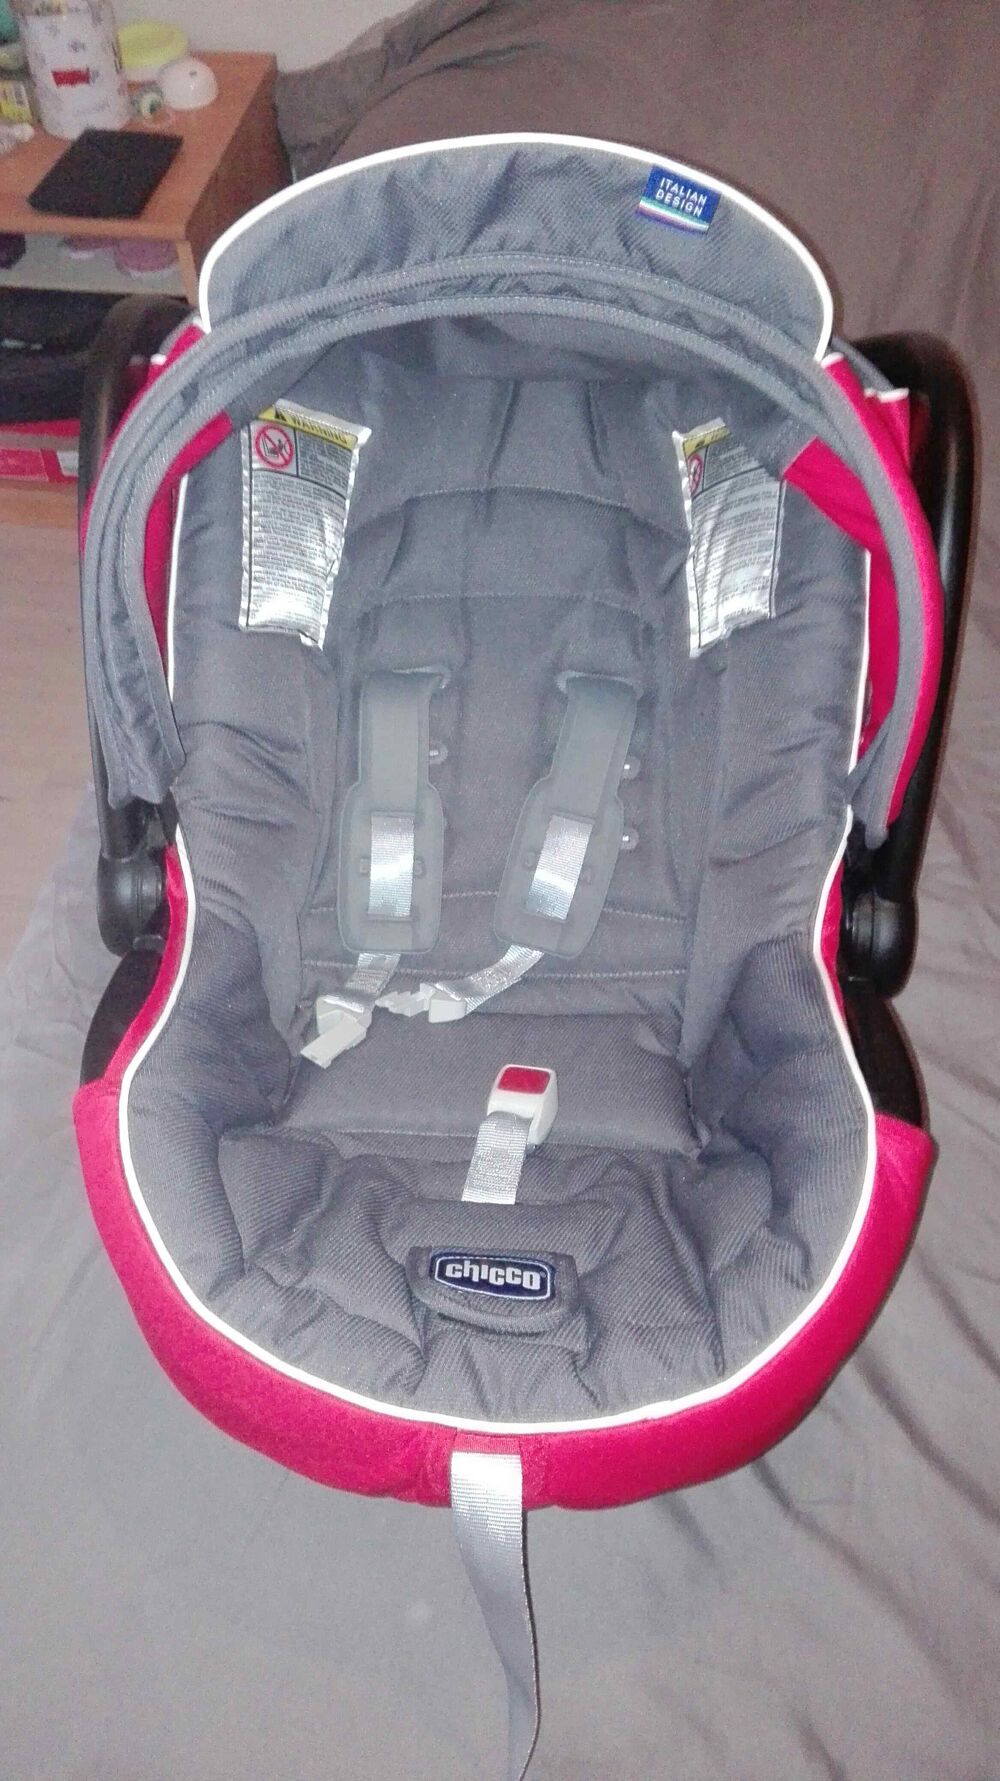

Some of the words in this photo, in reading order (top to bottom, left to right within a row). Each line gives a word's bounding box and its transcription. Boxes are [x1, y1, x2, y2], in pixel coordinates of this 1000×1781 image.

[655, 188, 703, 217] DESIGN
[660, 177, 708, 206] ITALIAN
[445, 1260, 541, 1291] chicco
